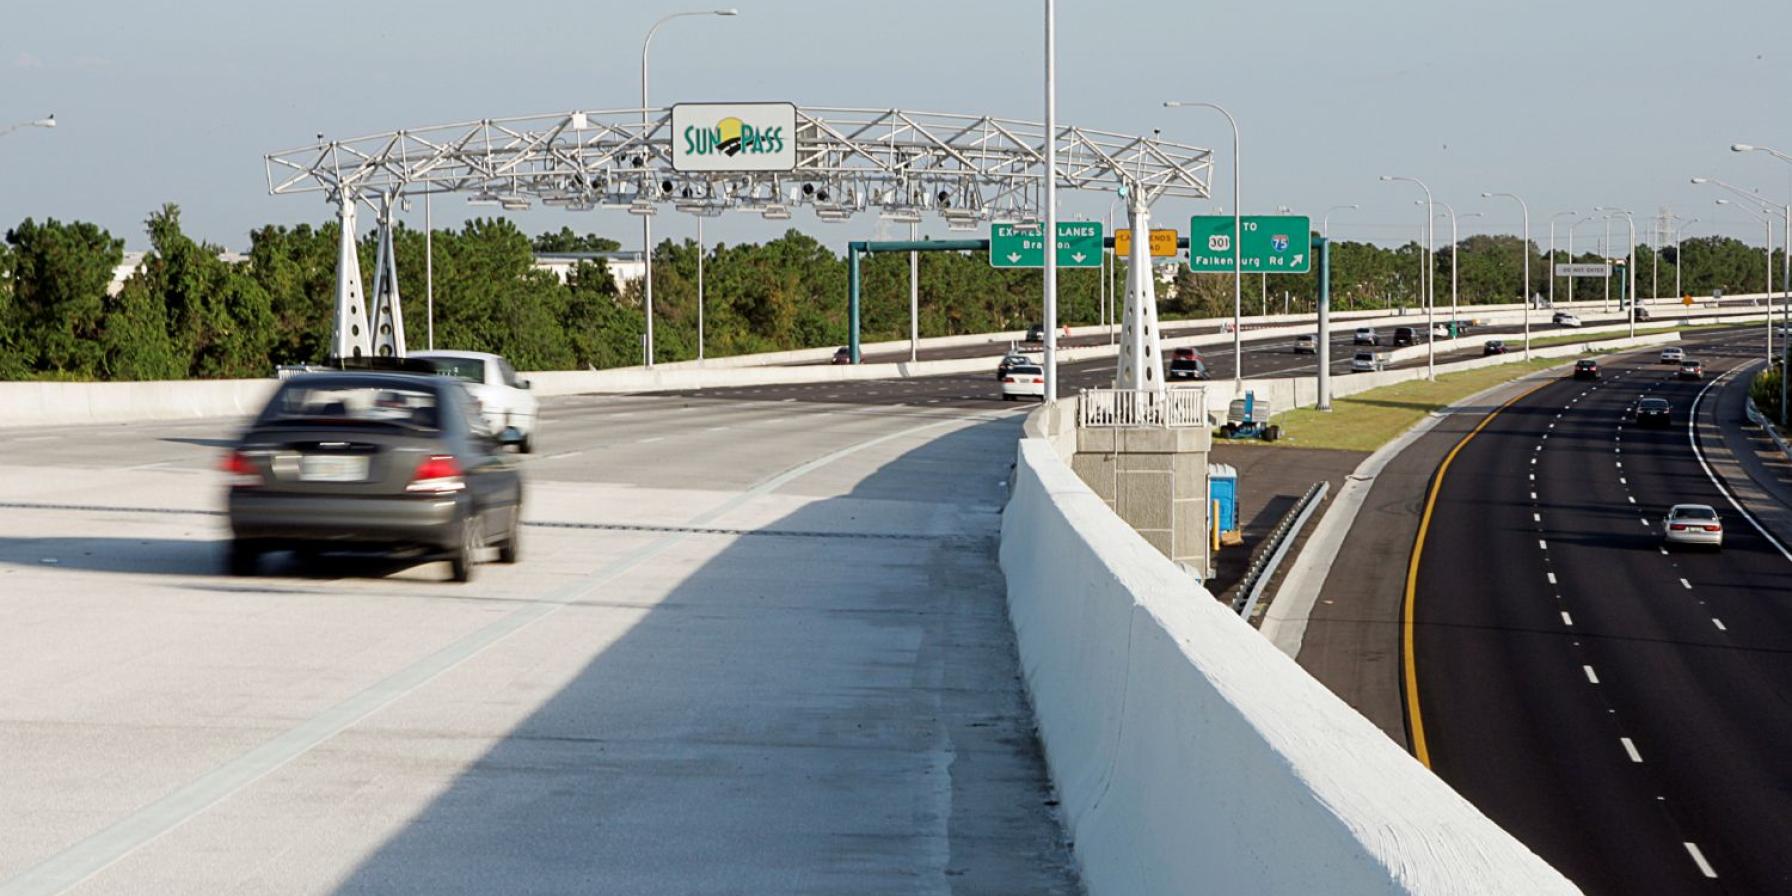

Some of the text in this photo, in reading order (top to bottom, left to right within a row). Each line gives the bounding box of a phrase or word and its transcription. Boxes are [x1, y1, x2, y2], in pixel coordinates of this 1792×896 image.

[684, 124, 783, 155] SUN PASS
[1243, 222, 1257, 231] TO
[998, 227, 1095, 237] EXPRES LANES
[1023, 240, 1070, 249] Braon
[1210, 237, 1228, 248] 301
[1273, 239, 1286, 249] 75
[1196, 256, 1283, 267] Falkenurg Rd
